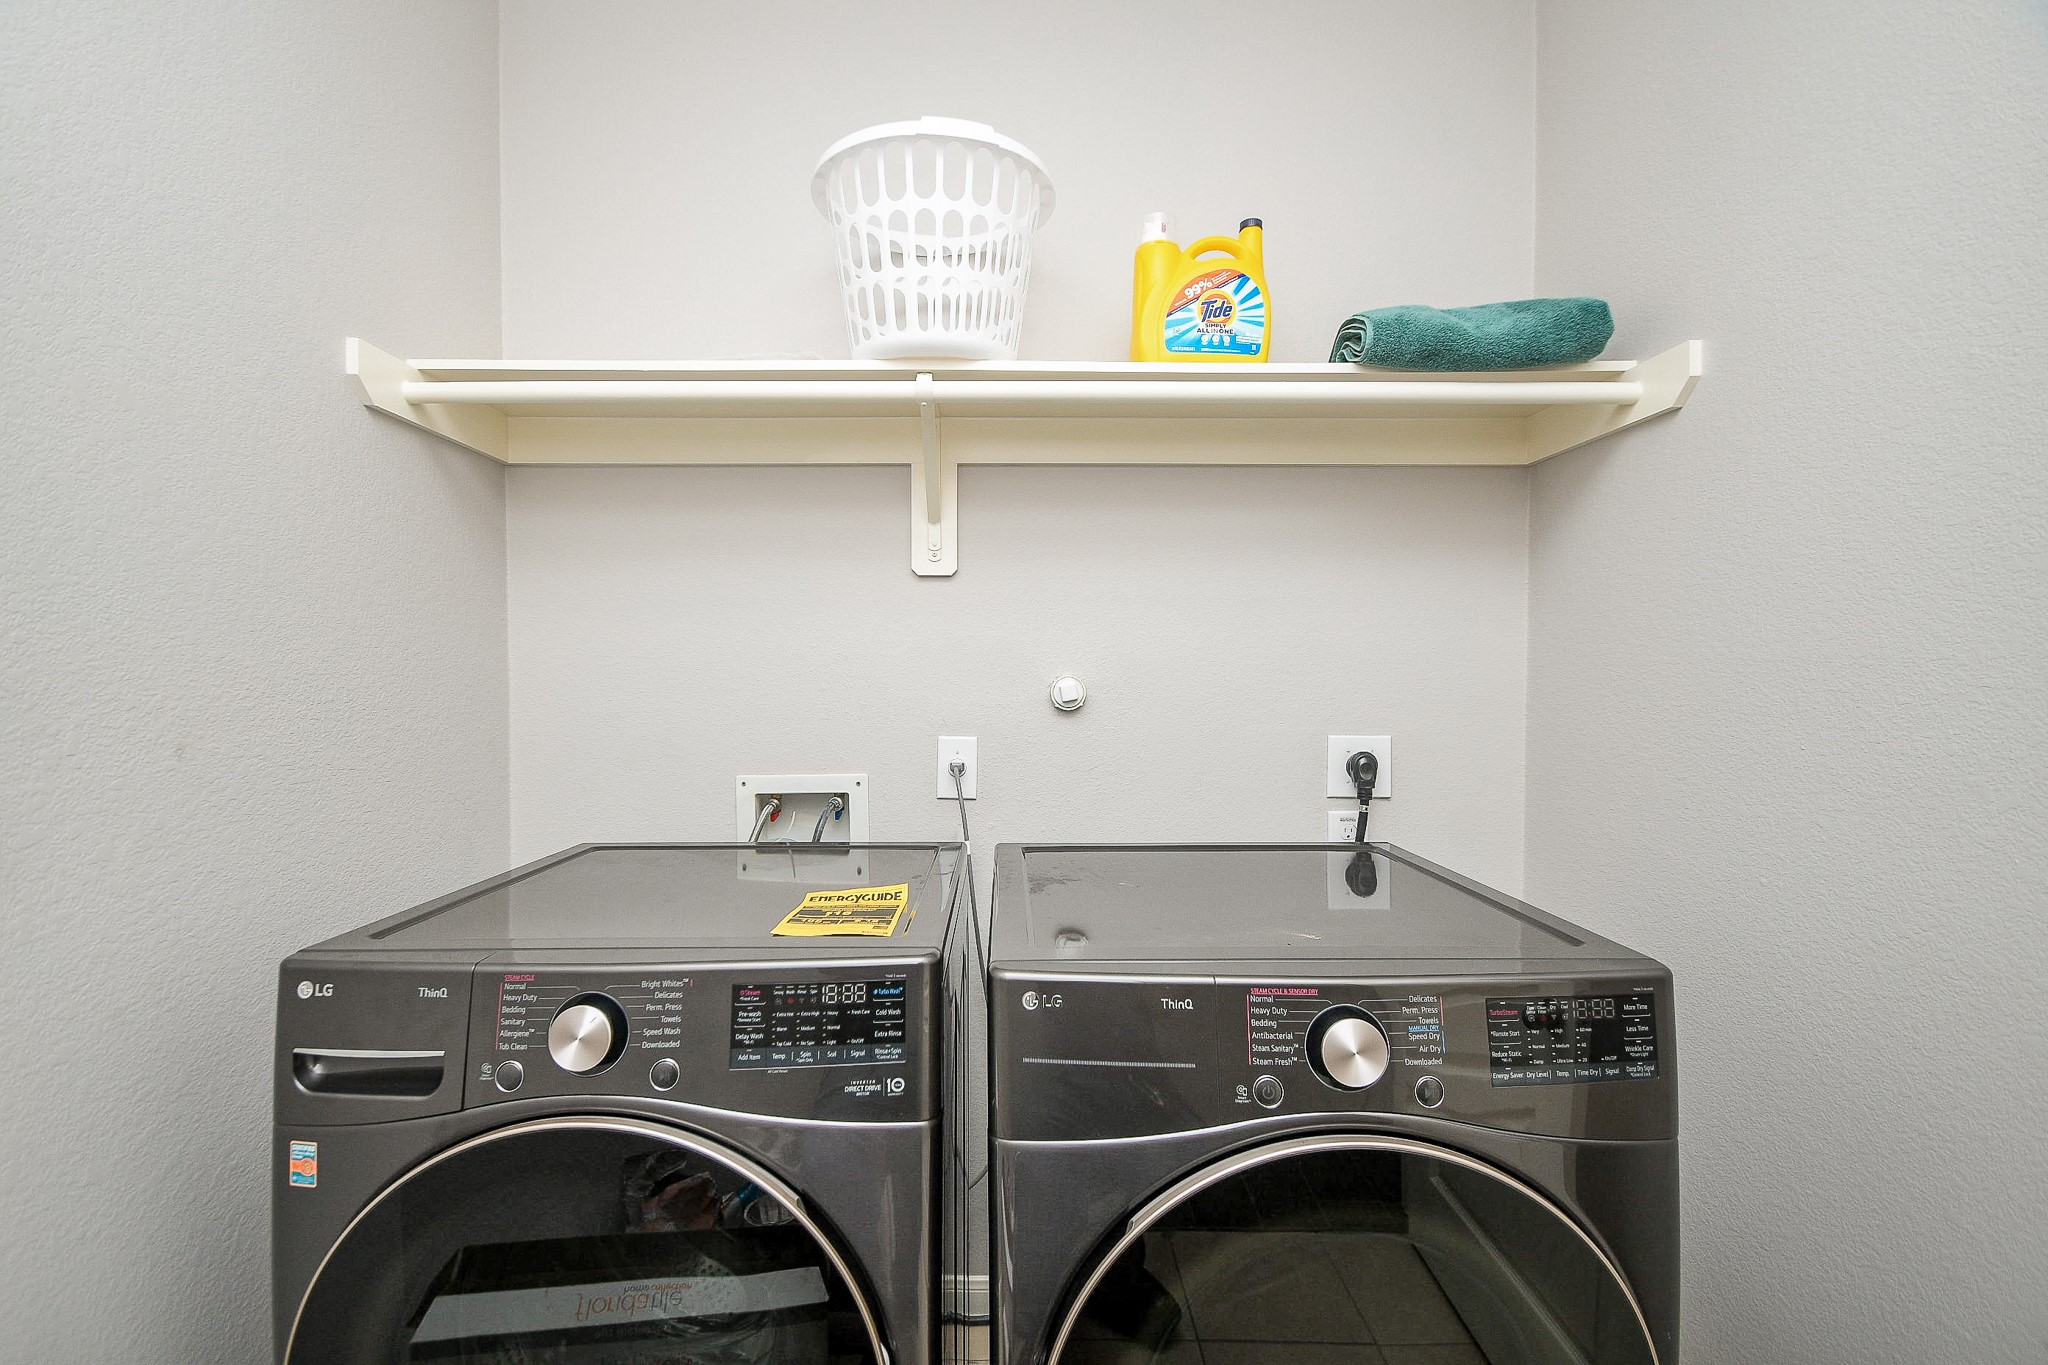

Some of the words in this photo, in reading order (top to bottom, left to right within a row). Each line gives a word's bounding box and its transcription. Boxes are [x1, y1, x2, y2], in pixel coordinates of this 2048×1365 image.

[1184, 278, 1213, 299] 99%
[1201, 300, 1233, 323] Tide
[809, 891, 903, 903] ENERGYGUIDE
[642, 980, 661, 989] Bright
[315, 984, 334, 997] LG
[418, 988, 447, 998] ThinQ
[503, 994, 521, 1002] Heavy
[523, 994, 537, 1002] Duty
[1043, 994, 1063, 1009] LG
[1161, 999, 1193, 1010] ThinQ
[502, 1006, 526, 1014] Bedding
[1251, 1007, 1270, 1016] Heavy
[1272, 1007, 1287, 1016] Duty
[501, 1018, 526, 1026] Sanitary
[1251, 1020, 1277, 1028] Bedding
[643, 1028, 661, 1036] Speed
[1252, 1032, 1293, 1040] Antibacterial
[1409, 1033, 1427, 1041] Speed
[1429, 1033, 1440, 1041] Dry
[642, 1041, 680, 1049] Downloaded
[1430, 1046, 1441, 1054] Dry
[800, 1051, 811, 1059] Spin
[1405, 1058, 1443, 1066] Downloaded
[1527, 1072, 1535, 1080] Dry
[887, 1078, 905, 1093] 10
